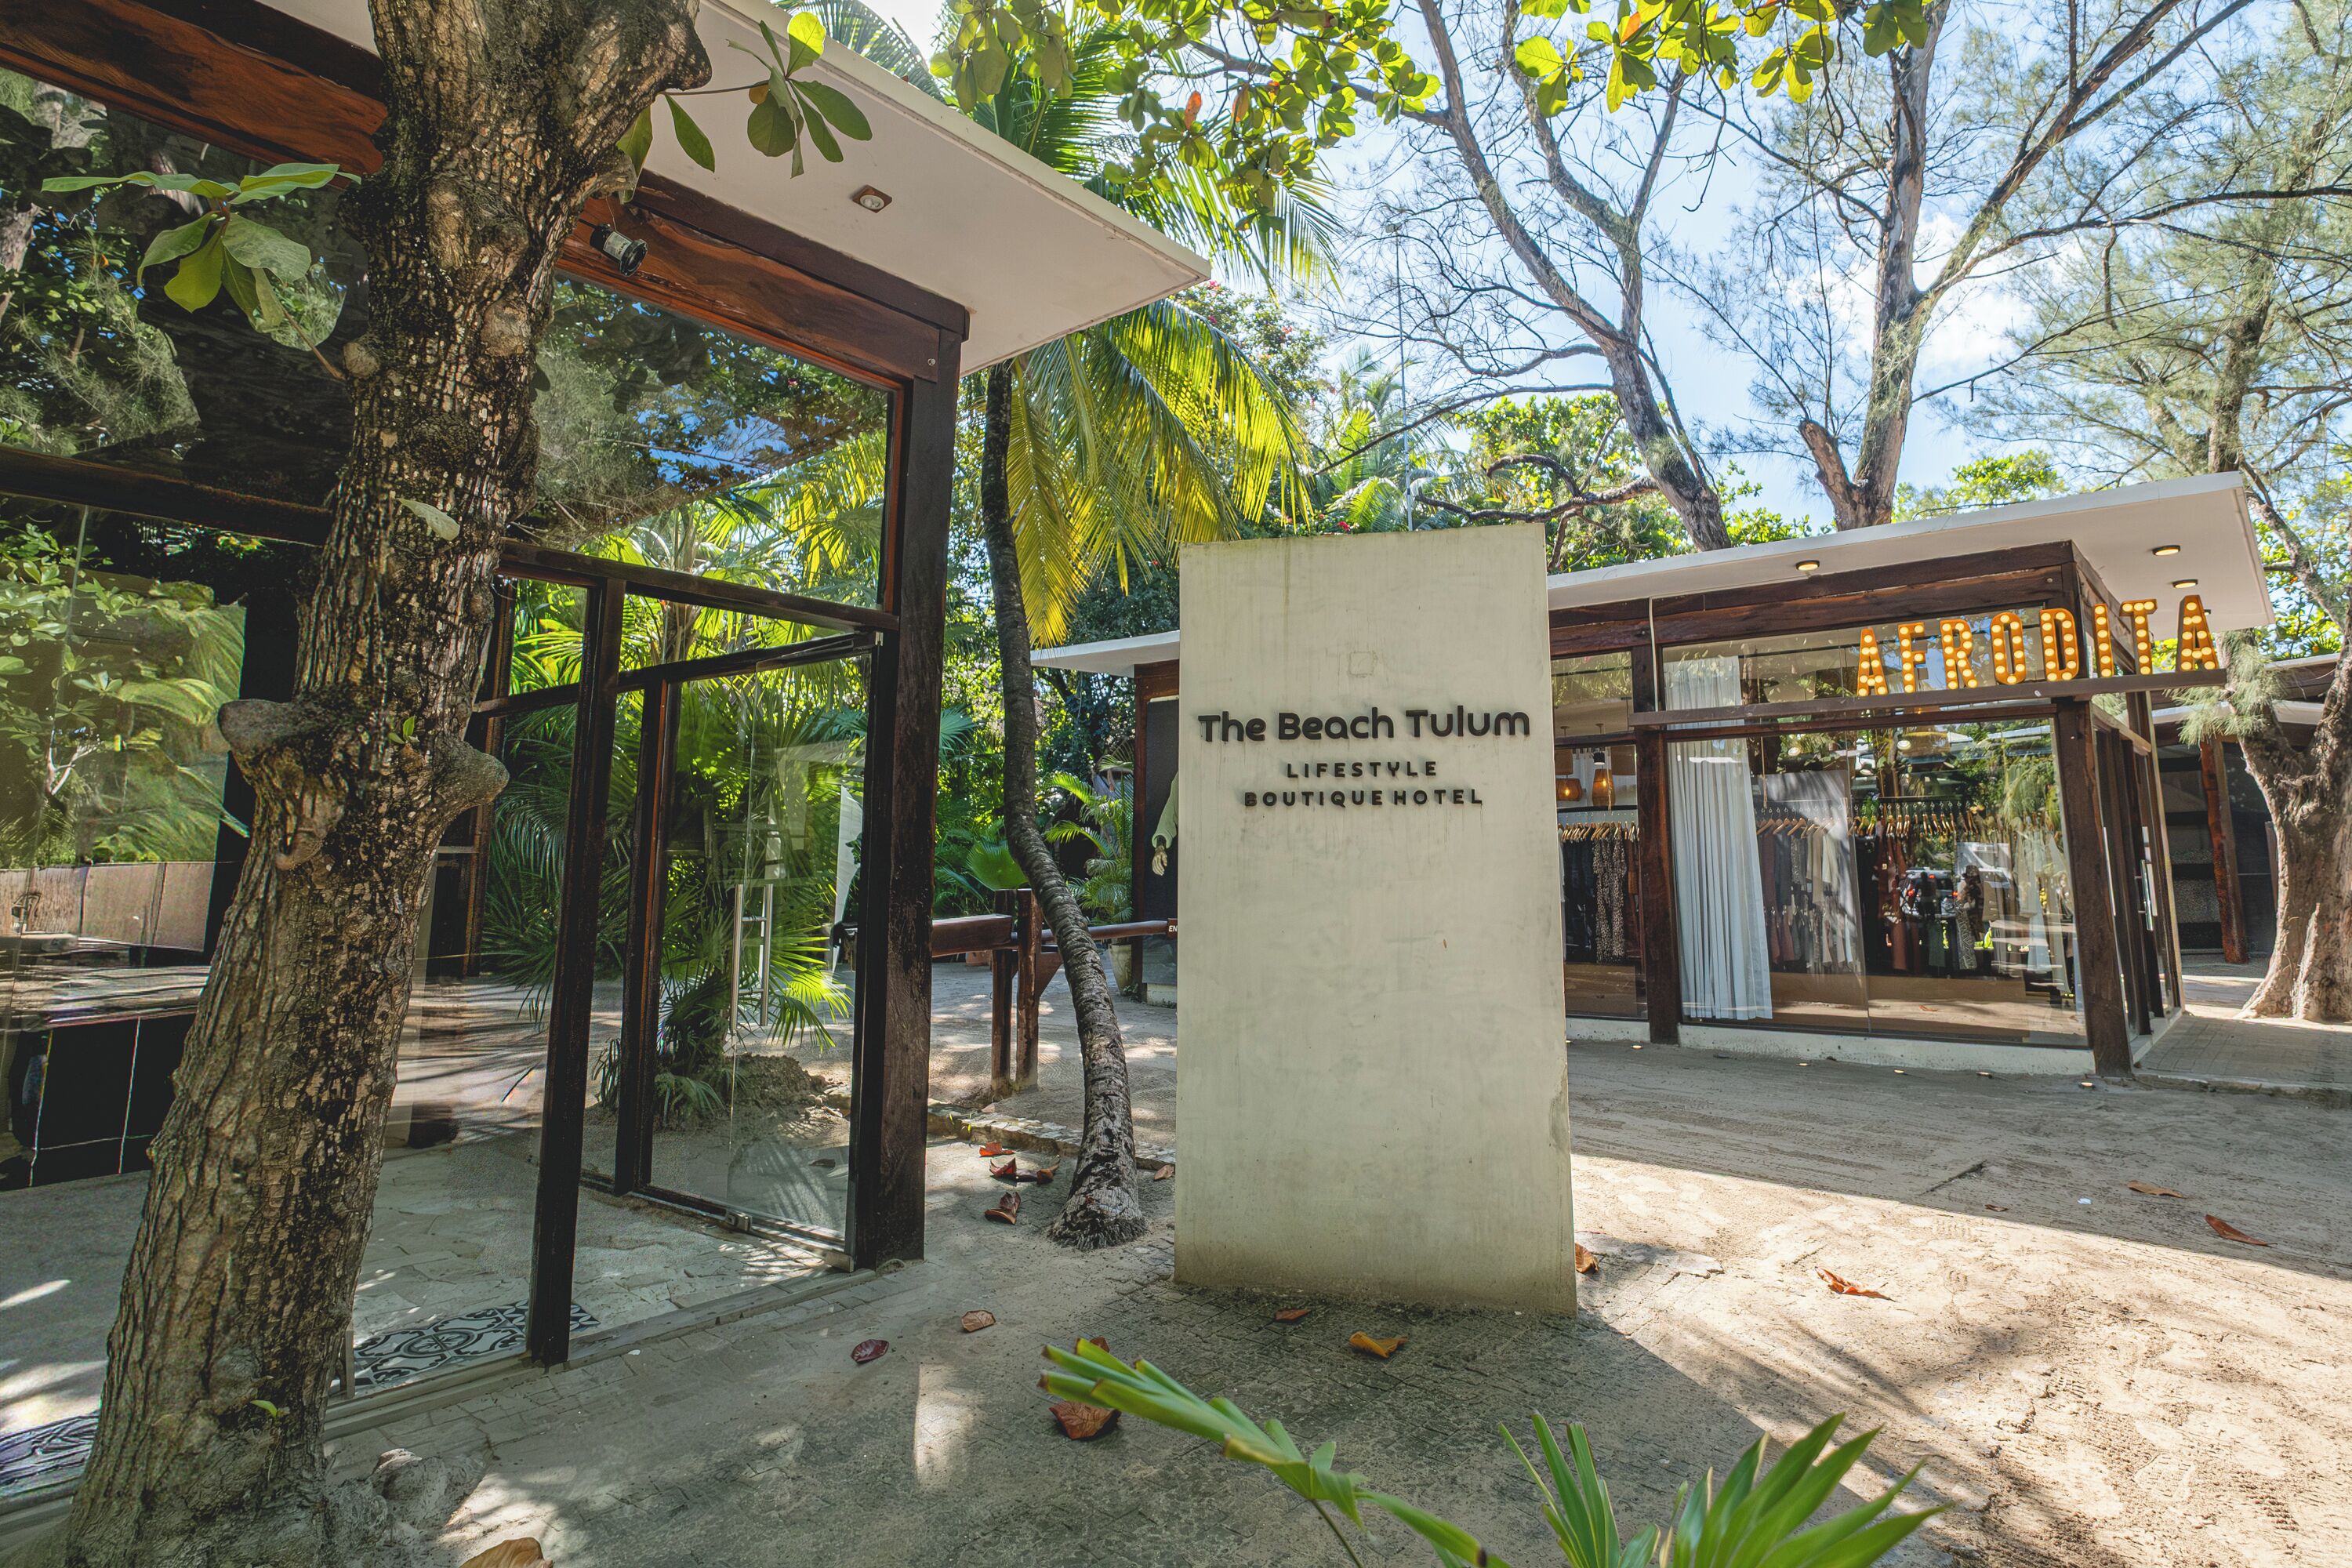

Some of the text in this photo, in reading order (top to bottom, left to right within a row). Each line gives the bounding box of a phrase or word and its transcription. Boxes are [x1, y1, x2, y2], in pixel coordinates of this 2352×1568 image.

[1857, 594, 2220, 697] AFRODITA
[1198, 706, 1530, 742] The Beach Tulum
[1287, 760, 1437, 778] LIFESTYLE
[1244, 789, 1483, 808] BOUTIQUE HOTEL
